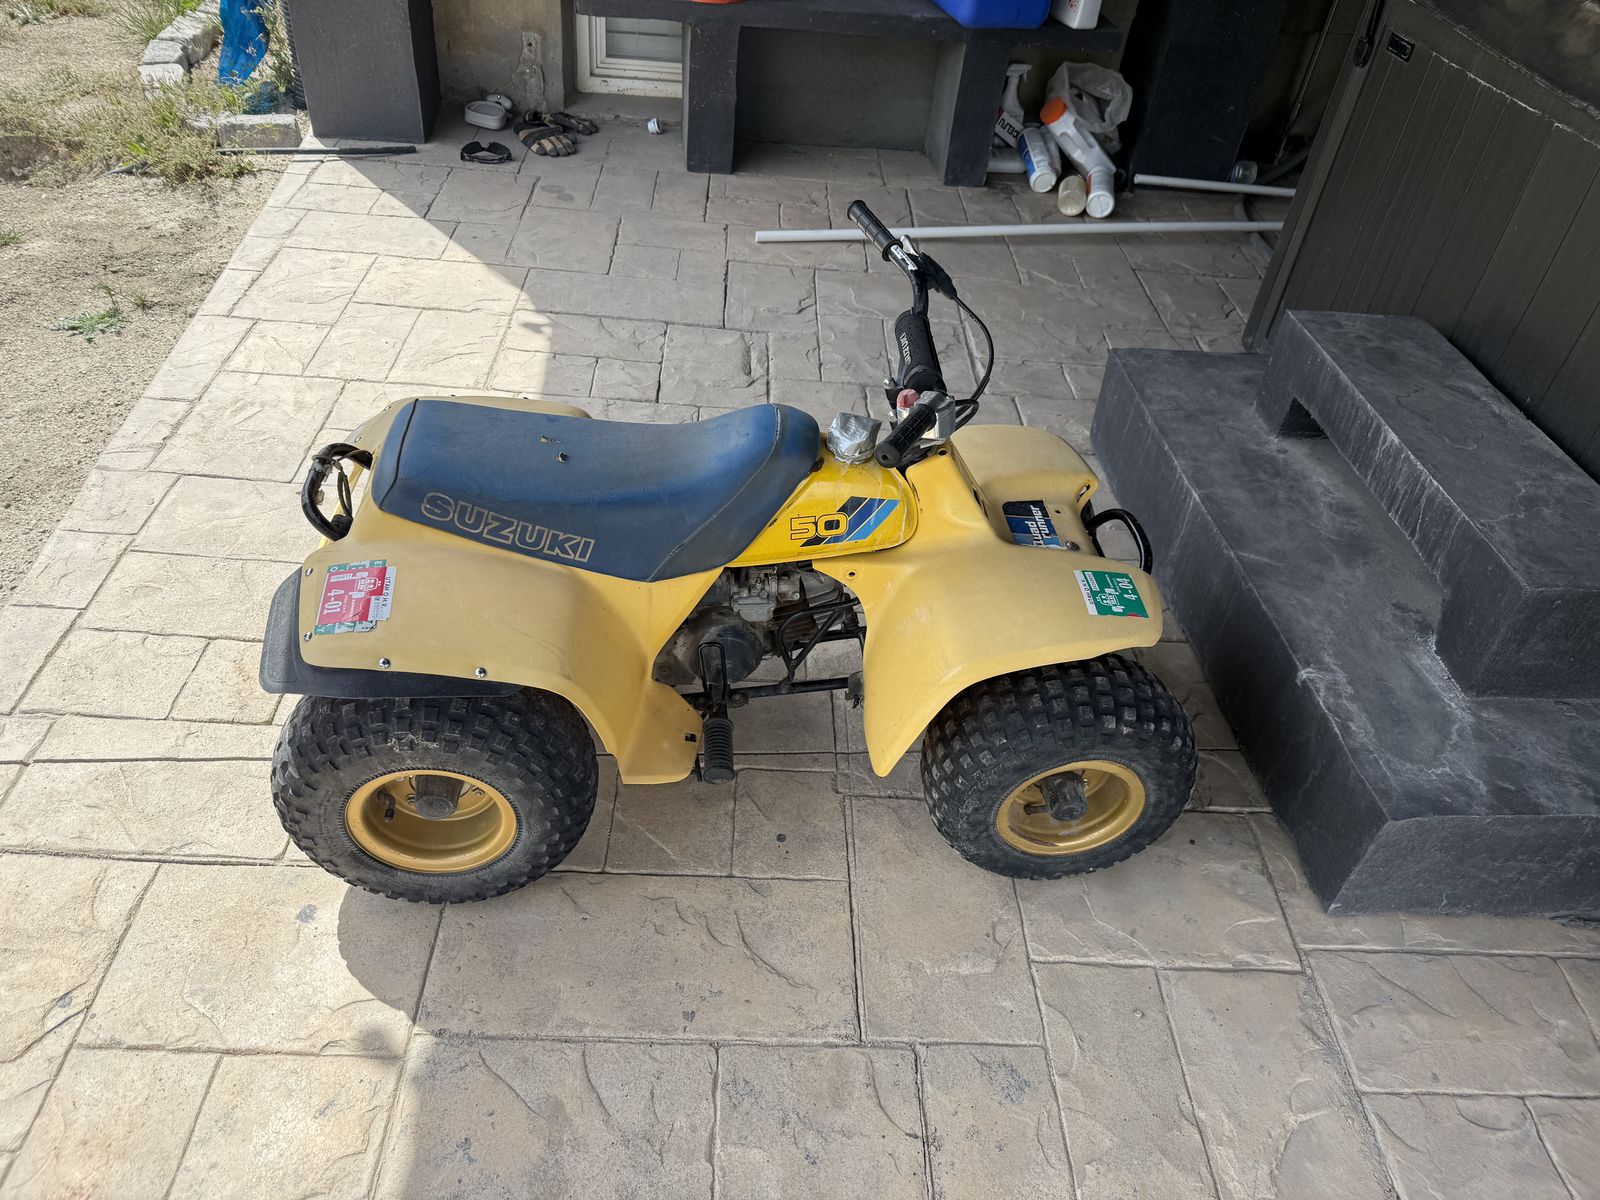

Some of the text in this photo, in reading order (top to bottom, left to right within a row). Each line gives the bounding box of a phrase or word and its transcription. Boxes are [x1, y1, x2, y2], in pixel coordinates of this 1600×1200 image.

[421, 491, 596, 563] SUZUKI
[790, 512, 849, 541] 50
[1030, 504, 1052, 539] runner
[324, 589, 345, 615] 4-01
[1116, 579, 1137, 600] 4-04
